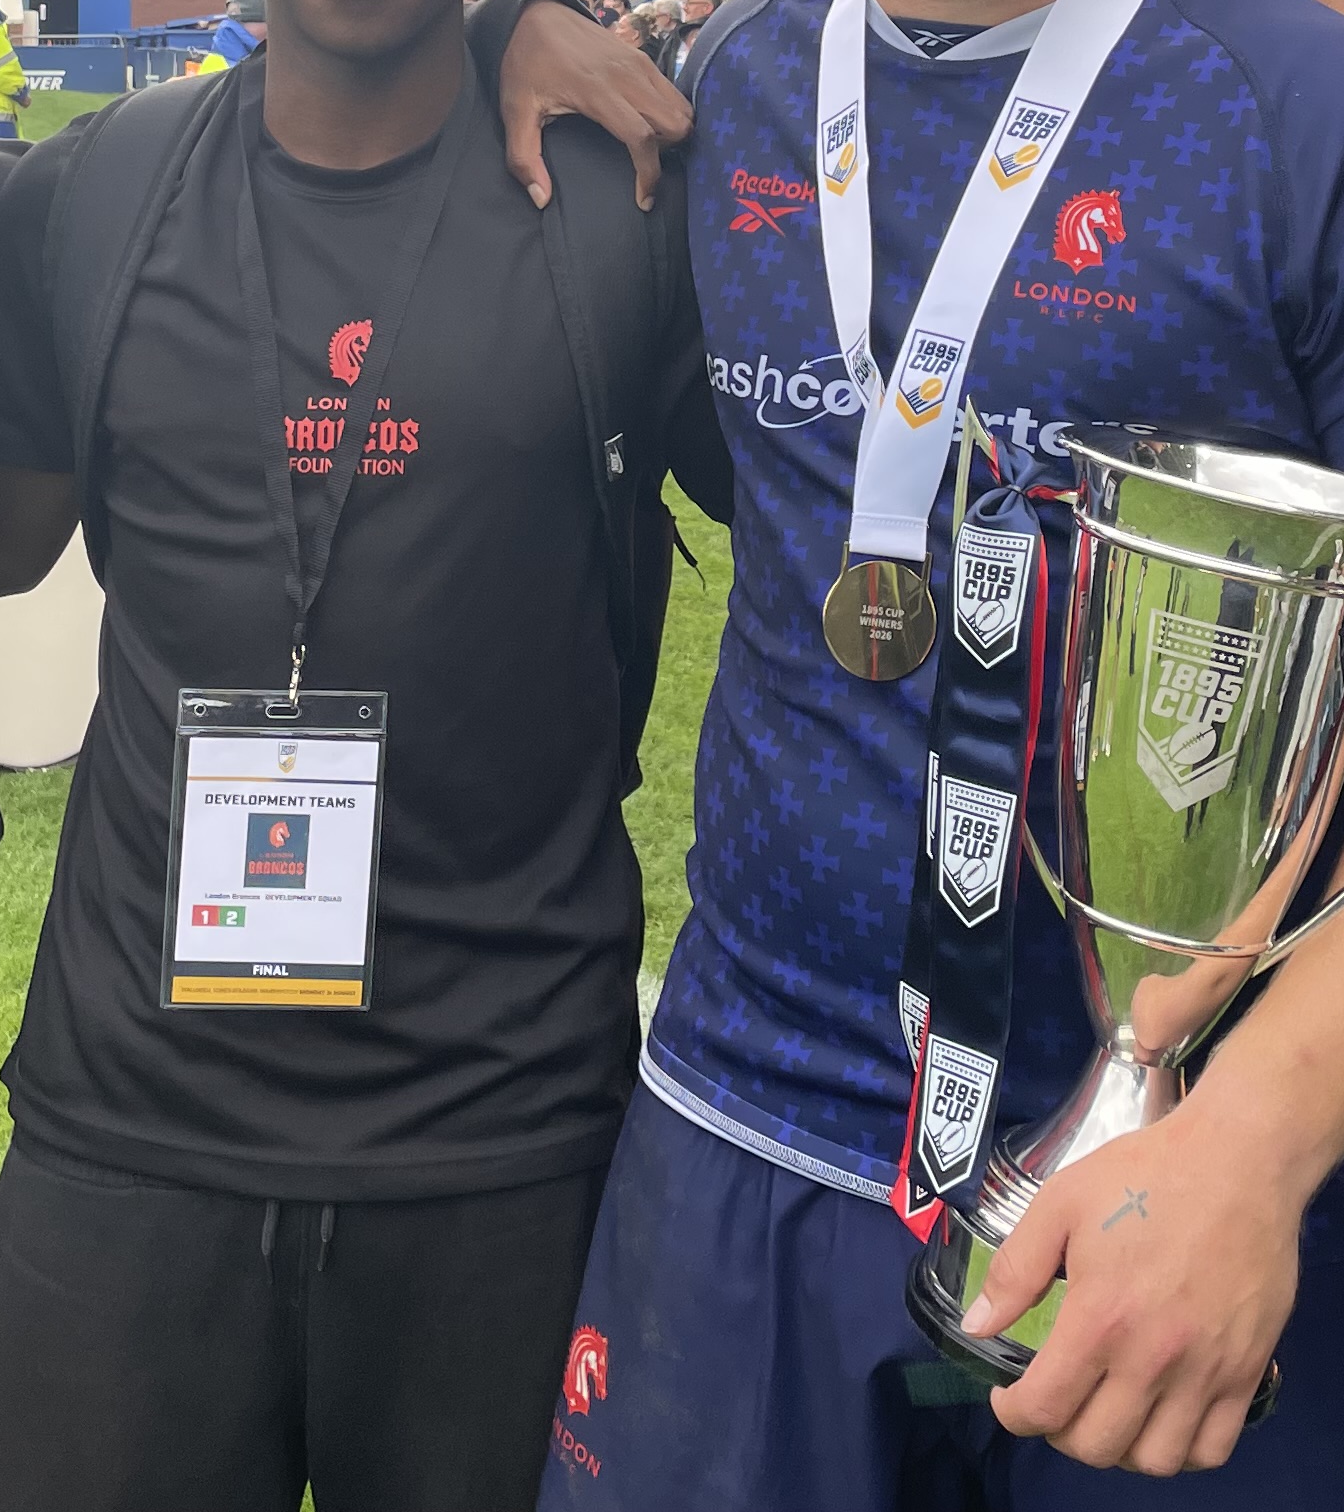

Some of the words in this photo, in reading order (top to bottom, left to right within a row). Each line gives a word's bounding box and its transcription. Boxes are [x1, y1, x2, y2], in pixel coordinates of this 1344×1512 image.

[827, 109, 856, 139] 1895
[1016, 107, 1061, 128] 1895
[827, 125, 854, 155] CUP
[1007, 122, 1051, 143] CUP
[730, 169, 816, 204] Reebok
[1014, 280, 1136, 313] LONDON
[917, 338, 960, 361] 1895
[909, 354, 953, 376] CUP
[308, 397, 391, 411] LONN
[289, 457, 405, 476] FOUNTION
[965, 559, 1017, 586] 1895
[962, 578, 1011, 602] CUP
[859, 615, 904, 630] WINNERS
[861, 604, 884, 616] 1895
[885, 608, 905, 618] CUP
[1159, 659, 1246, 704] 1895
[1150, 686, 1233, 725] CUP
[205, 793, 306, 808] DEVELOPMENT
[309, 795, 357, 809] TEAMS
[953, 815, 1001, 844] 1895
[949, 833, 995, 860] CUP
[201, 910, 209, 925] 1
[226, 910, 238, 926] 2
[252, 964, 289, 976] FINAL
[936, 1074, 983, 1109] 1895
[932, 1095, 976, 1123] CUP
